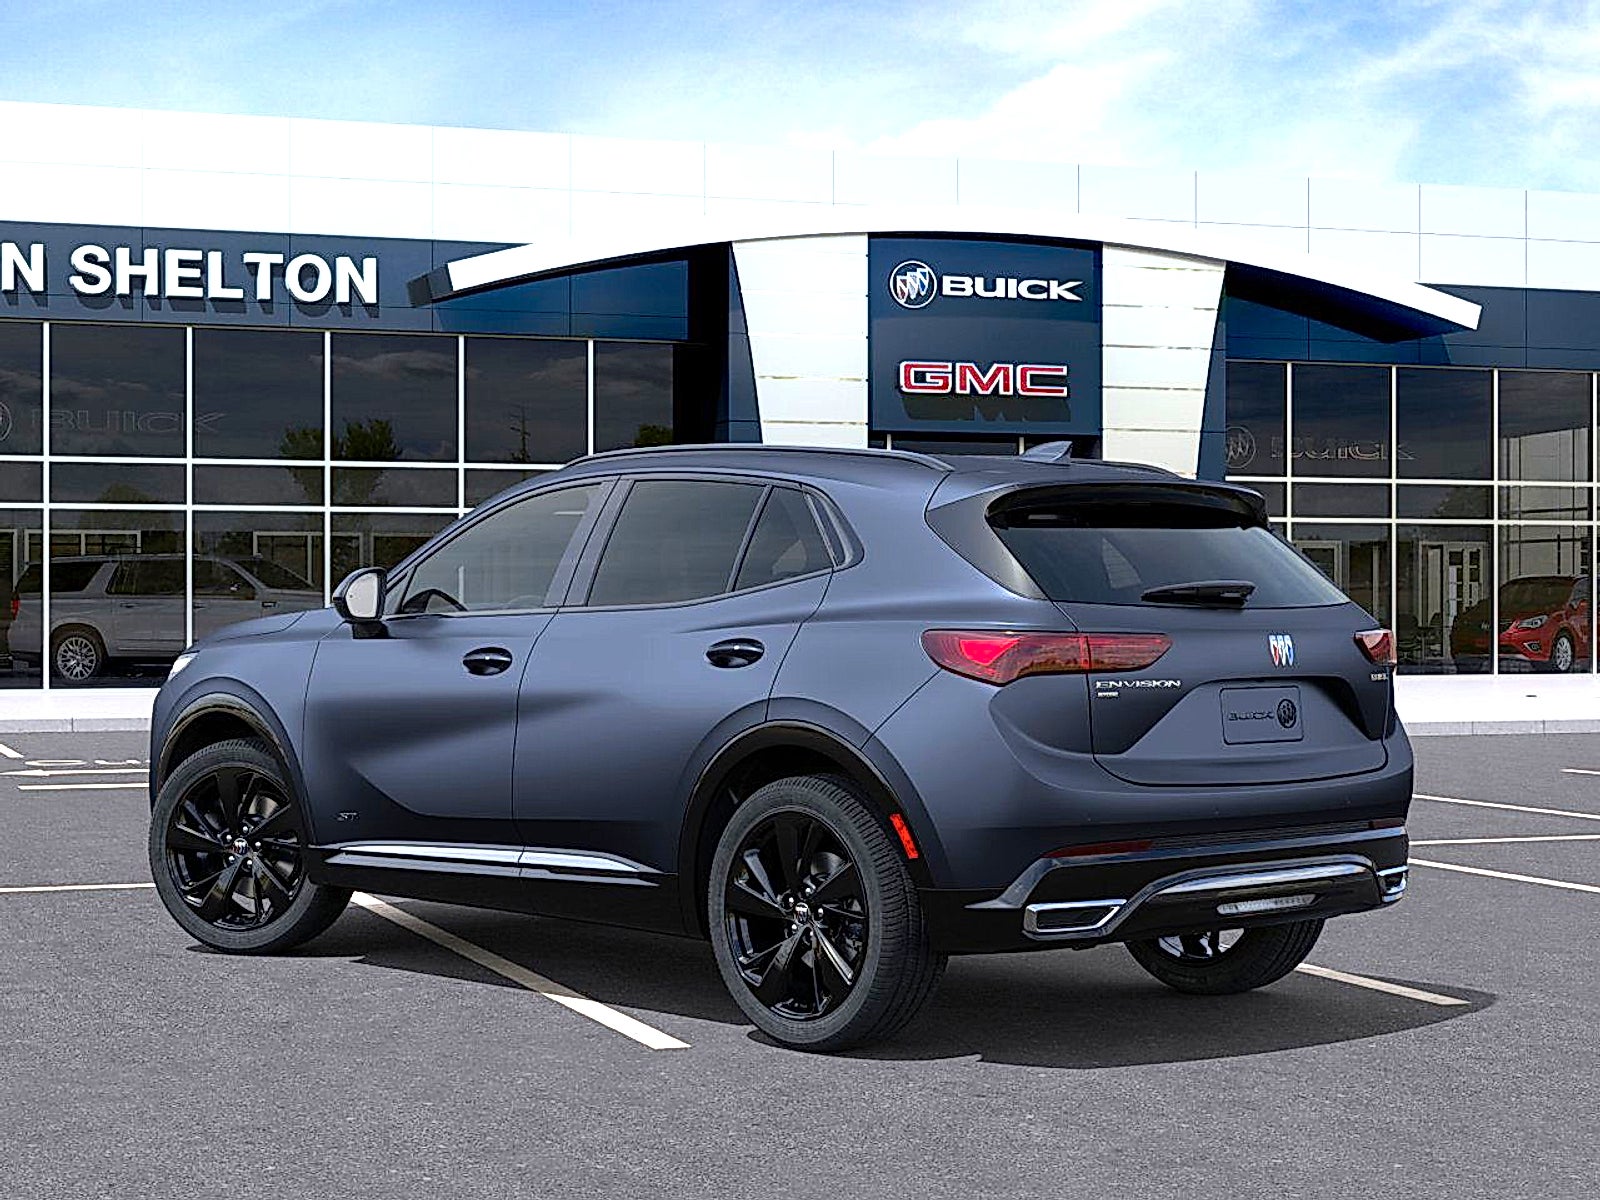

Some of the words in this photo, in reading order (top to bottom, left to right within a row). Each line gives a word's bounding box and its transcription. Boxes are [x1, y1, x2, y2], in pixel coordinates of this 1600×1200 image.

[68, 243, 378, 305] SHELTON
[941, 274, 1084, 302] BUICK
[899, 360, 1068, 398] GMC
[1095, 679, 1182, 689] ENVISION
